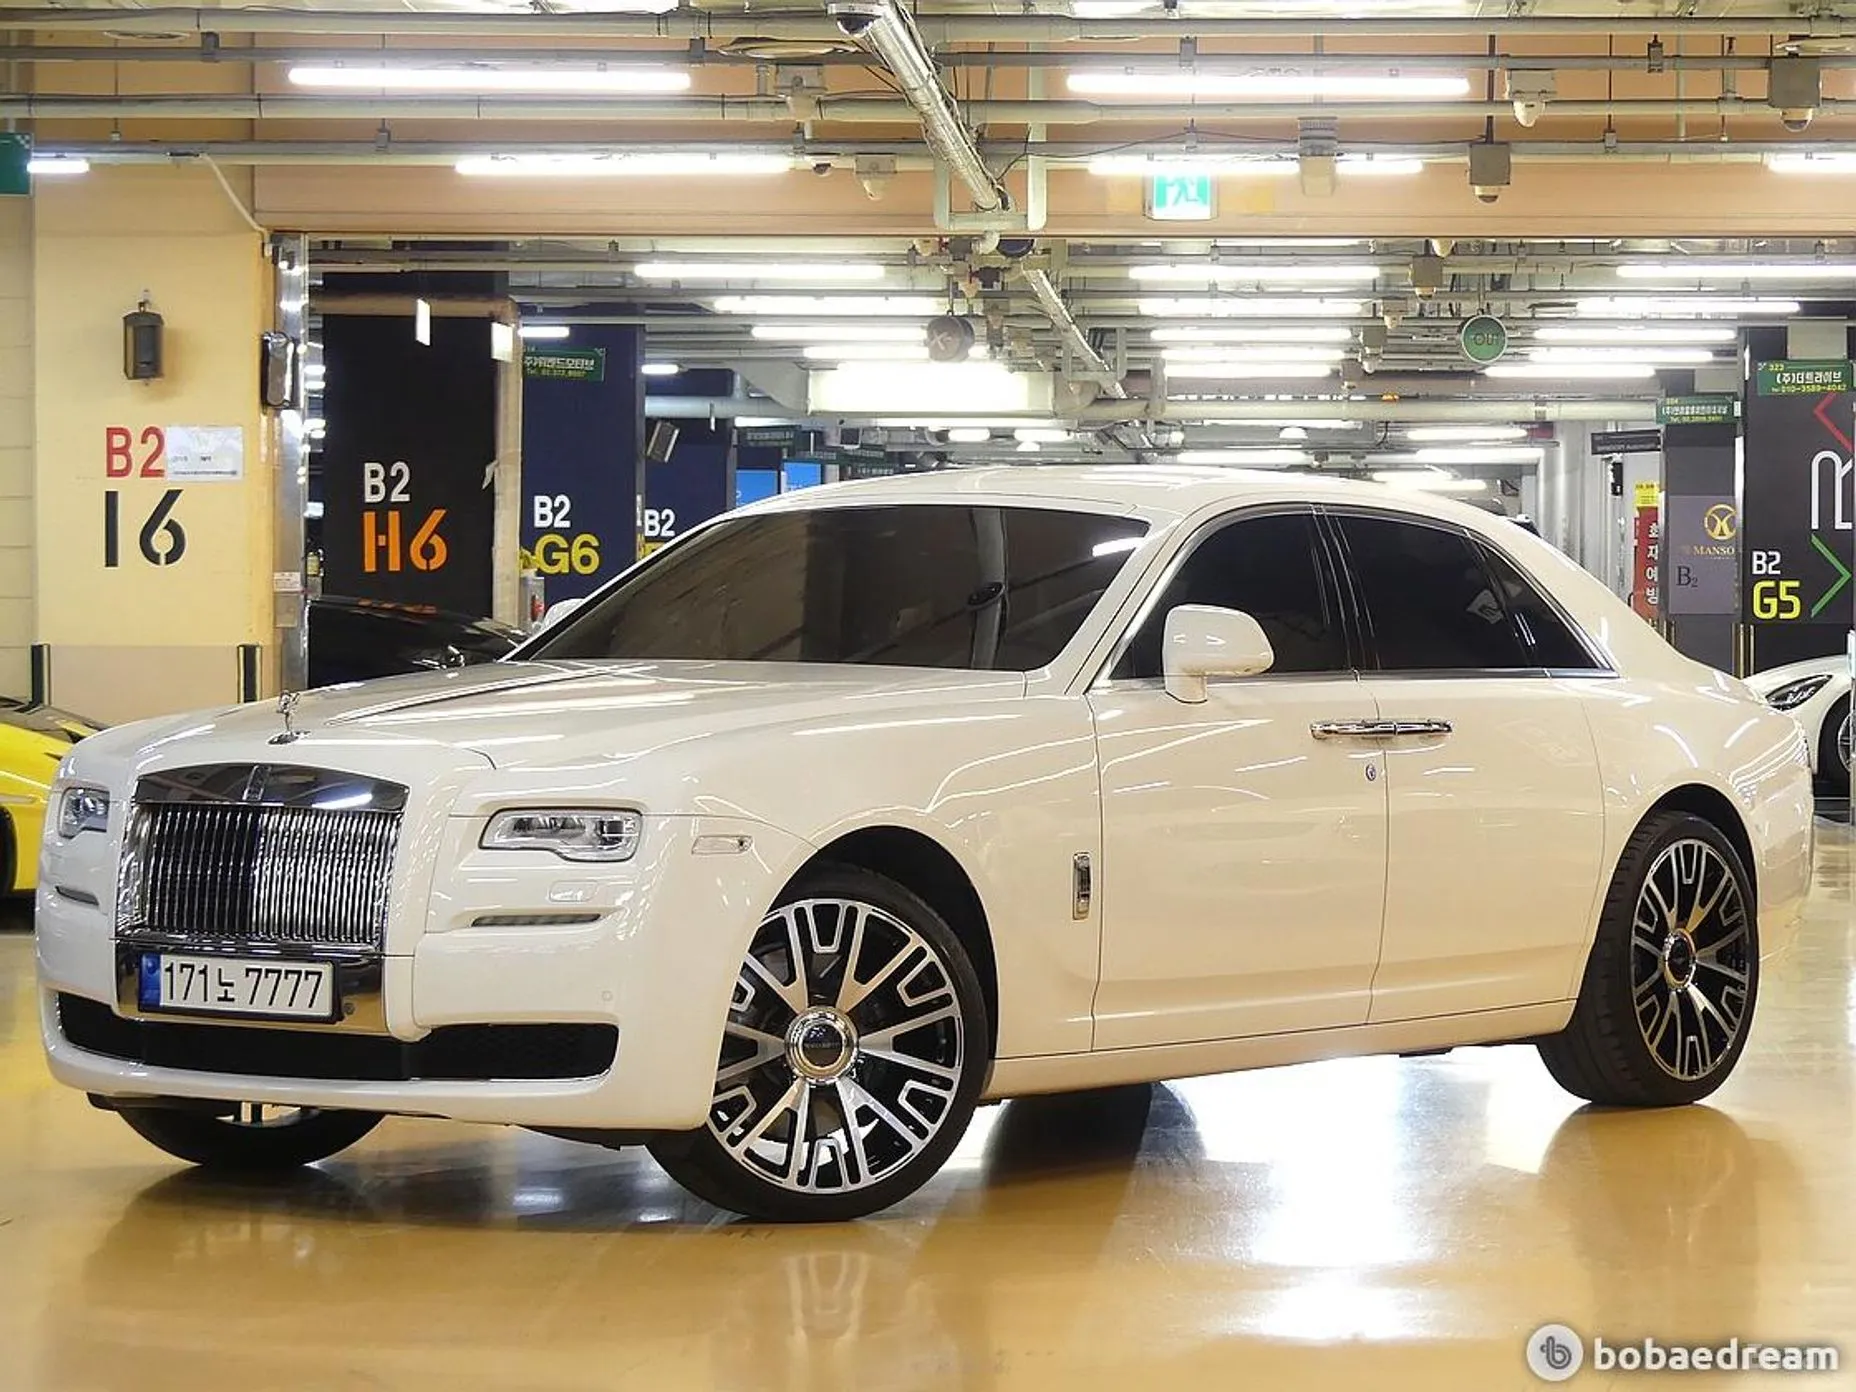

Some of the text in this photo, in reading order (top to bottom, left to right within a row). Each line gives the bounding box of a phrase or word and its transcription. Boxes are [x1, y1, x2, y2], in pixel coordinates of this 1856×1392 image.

[106, 426, 165, 478] B2
[363, 461, 411, 503] B2
[534, 494, 571, 528] B2
[644, 508, 676, 537] B2
[363, 509, 447, 573] H6
[535, 533, 600, 575] G6
[1676, 565, 1699, 588] B2
[1752, 551, 1781, 575] B2
[1752, 580, 1801, 621] G5
[164, 962, 323, 1009] 171노 7777
